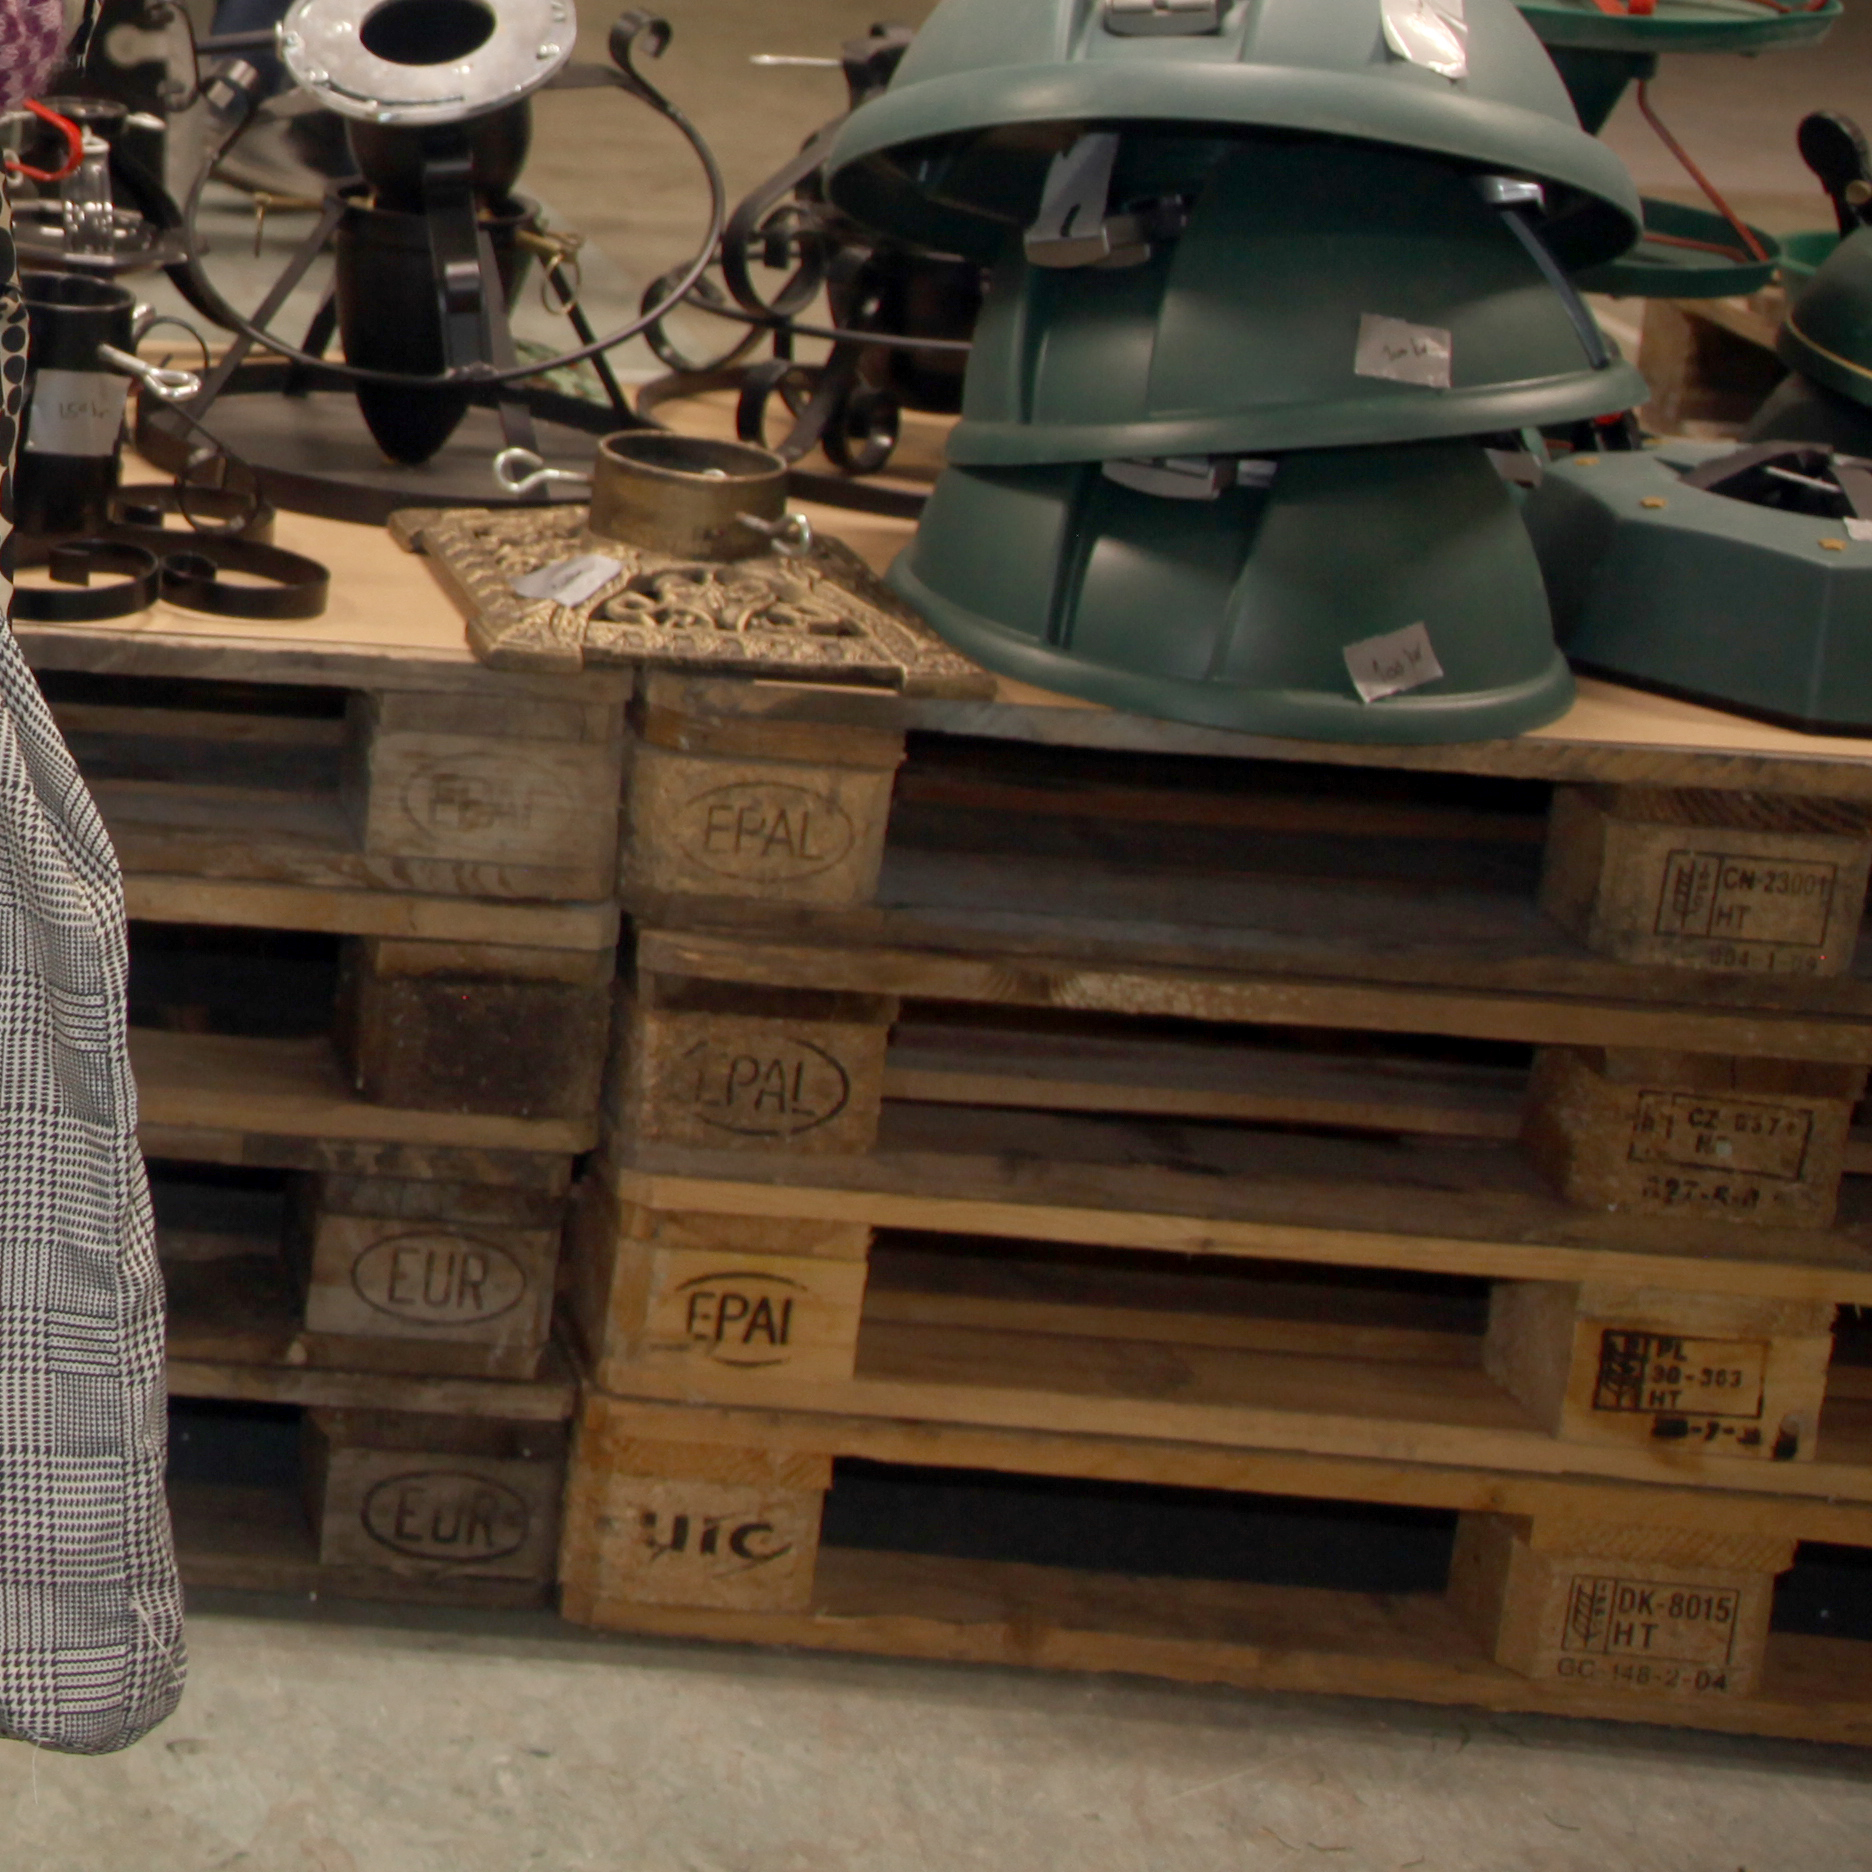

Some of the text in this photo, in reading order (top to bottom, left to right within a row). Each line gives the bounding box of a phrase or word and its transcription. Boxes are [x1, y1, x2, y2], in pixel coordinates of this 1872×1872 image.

[702, 803, 827, 863] EPAL
[1715, 903, 1752, 930] HT
[387, 1247, 491, 1311] EUR
[1649, 1388, 1684, 1409] HT
[393, 1485, 499, 1549] EUR
[1618, 1585, 1733, 1623] DK-8015
[1613, 1619, 1660, 1650] HT
